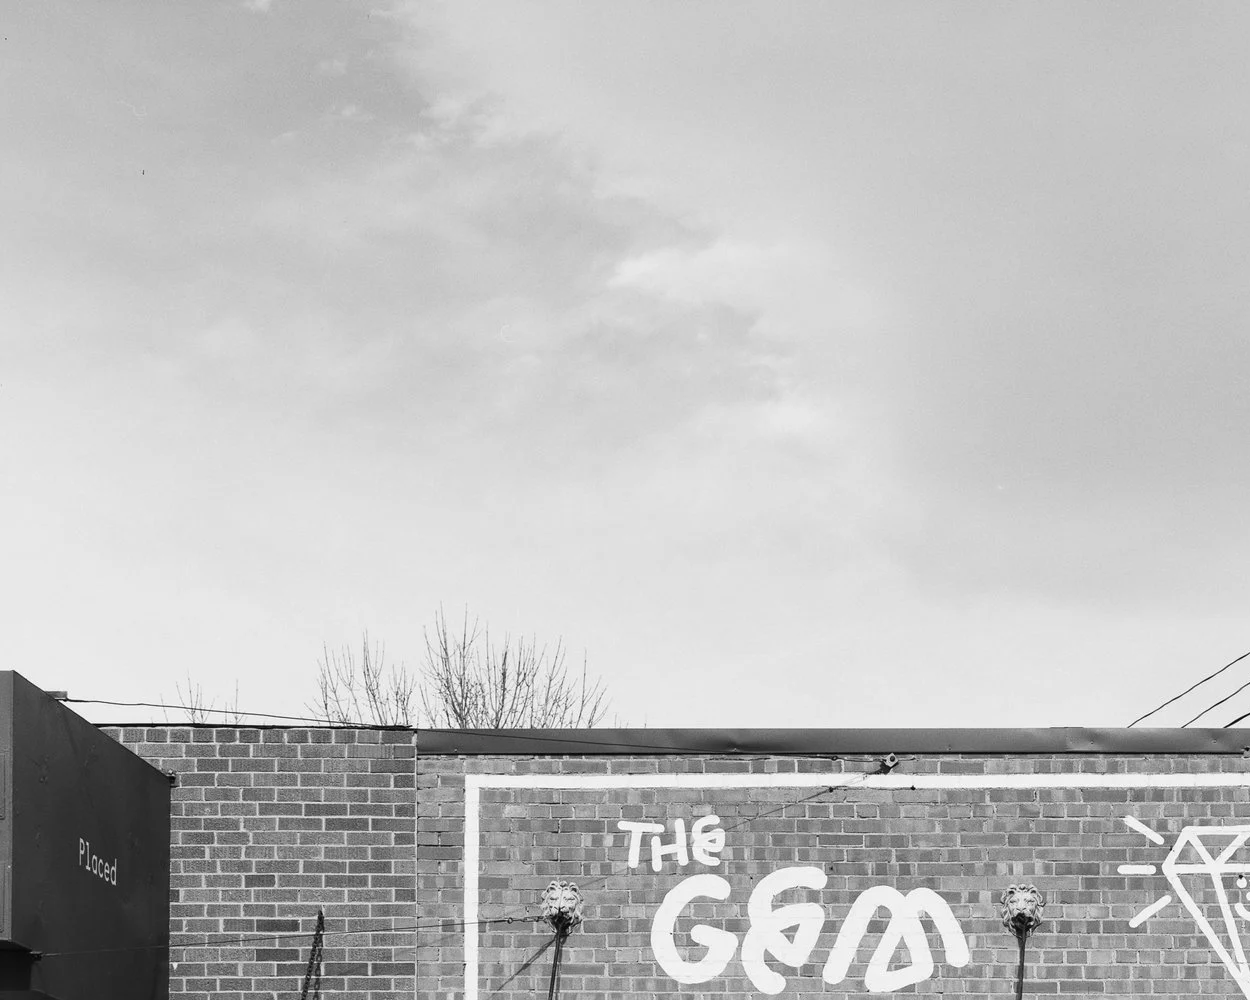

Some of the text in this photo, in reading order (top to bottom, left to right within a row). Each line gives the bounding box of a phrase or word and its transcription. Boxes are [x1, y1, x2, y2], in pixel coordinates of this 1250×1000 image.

[79, 837, 117, 886] Placed
[617, 814, 725, 872] THE
[650, 866, 970, 995] GEM
